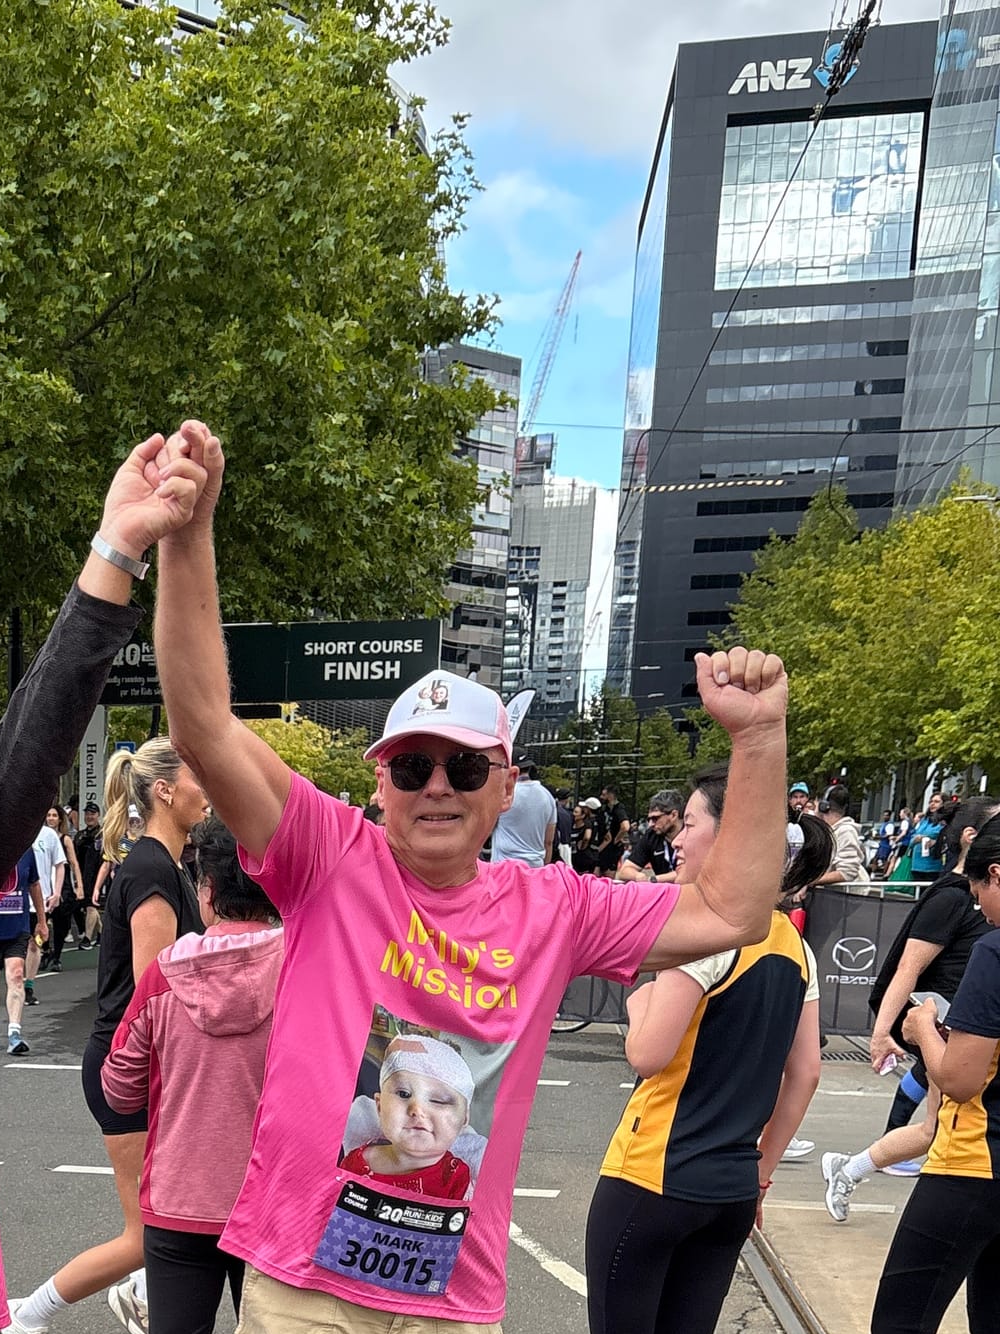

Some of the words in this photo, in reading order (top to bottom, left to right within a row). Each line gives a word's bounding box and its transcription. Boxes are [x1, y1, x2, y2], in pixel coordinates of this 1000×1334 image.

[728, 57, 813, 95] ANZ
[304, 641, 356, 656] SHORT
[359, 639, 423, 654] COURSE
[324, 660, 401, 681] FINISH
[86, 743, 97, 788] Herald
[343, 1197, 369, 1212] COURSE
[348, 1191, 369, 1204] SHORT
[403, 1209, 421, 1220] RUN
[425, 1213, 445, 1223] KIDS
[372, 1232, 425, 1253] MARK
[338, 1240, 437, 1286] 30015
